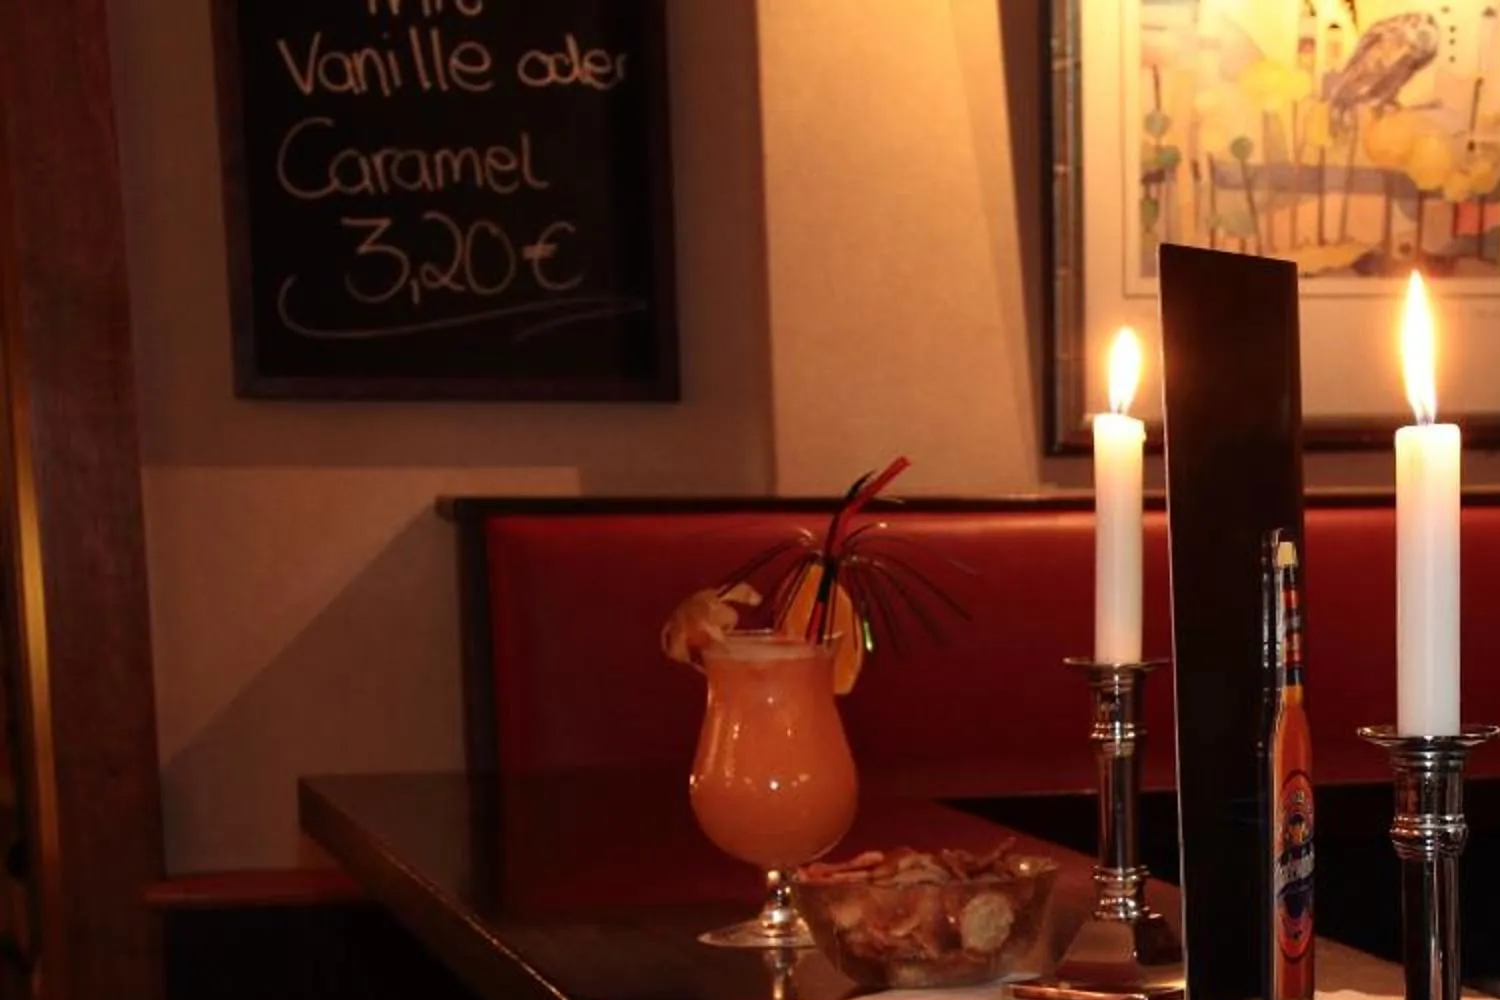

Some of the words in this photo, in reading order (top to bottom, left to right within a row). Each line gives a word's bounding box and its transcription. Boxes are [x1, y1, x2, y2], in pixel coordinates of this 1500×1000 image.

[277, 27, 495, 96] Vanille
[517, 33, 631, 90] oder
[276, 116, 549, 199] Caramel
